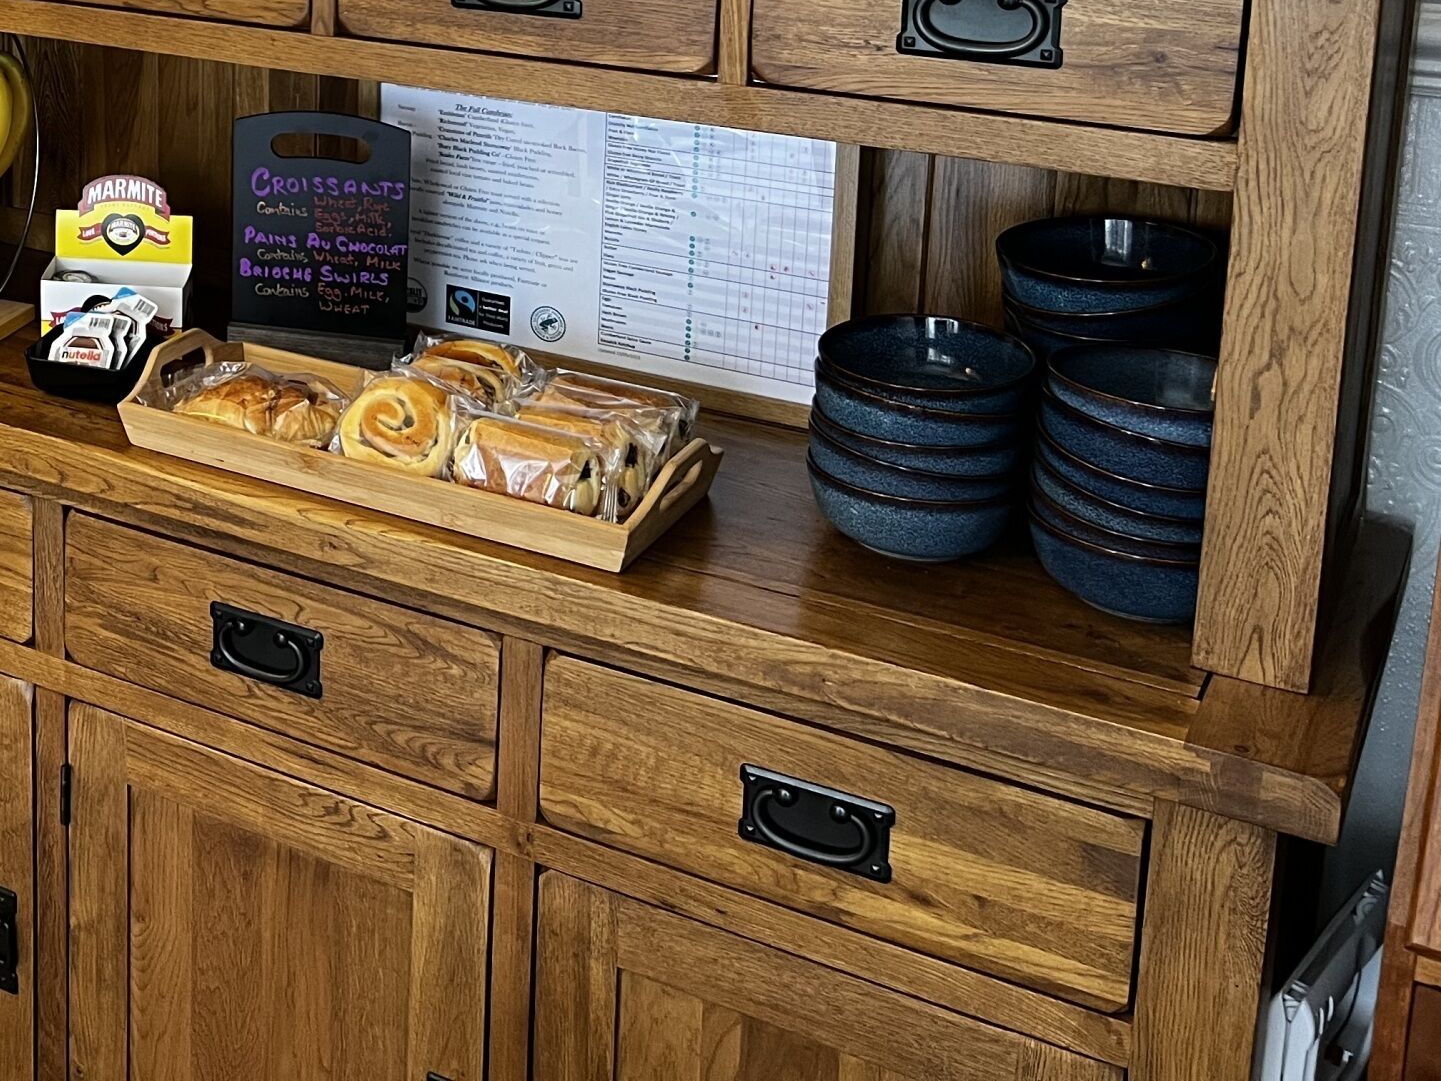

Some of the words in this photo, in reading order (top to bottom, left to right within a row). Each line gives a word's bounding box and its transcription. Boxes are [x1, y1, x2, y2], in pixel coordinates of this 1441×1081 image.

[250, 167, 406, 201] CROISSANTS
[87, 178, 164, 208] MARMITE
[256, 201, 308, 218] Contains
[243, 225, 297, 248] PAINS
[306, 232, 331, 251] AU
[334, 235, 408, 256] CHOCOLAT
[256, 248, 309, 263] Contains
[239, 258, 312, 282] BRIOCHE
[319, 265, 389, 286] SWIRLS
[255, 283, 310, 298] Contains
[318, 300, 370, 315] WHEAT
[61, 349, 101, 361] nutella
